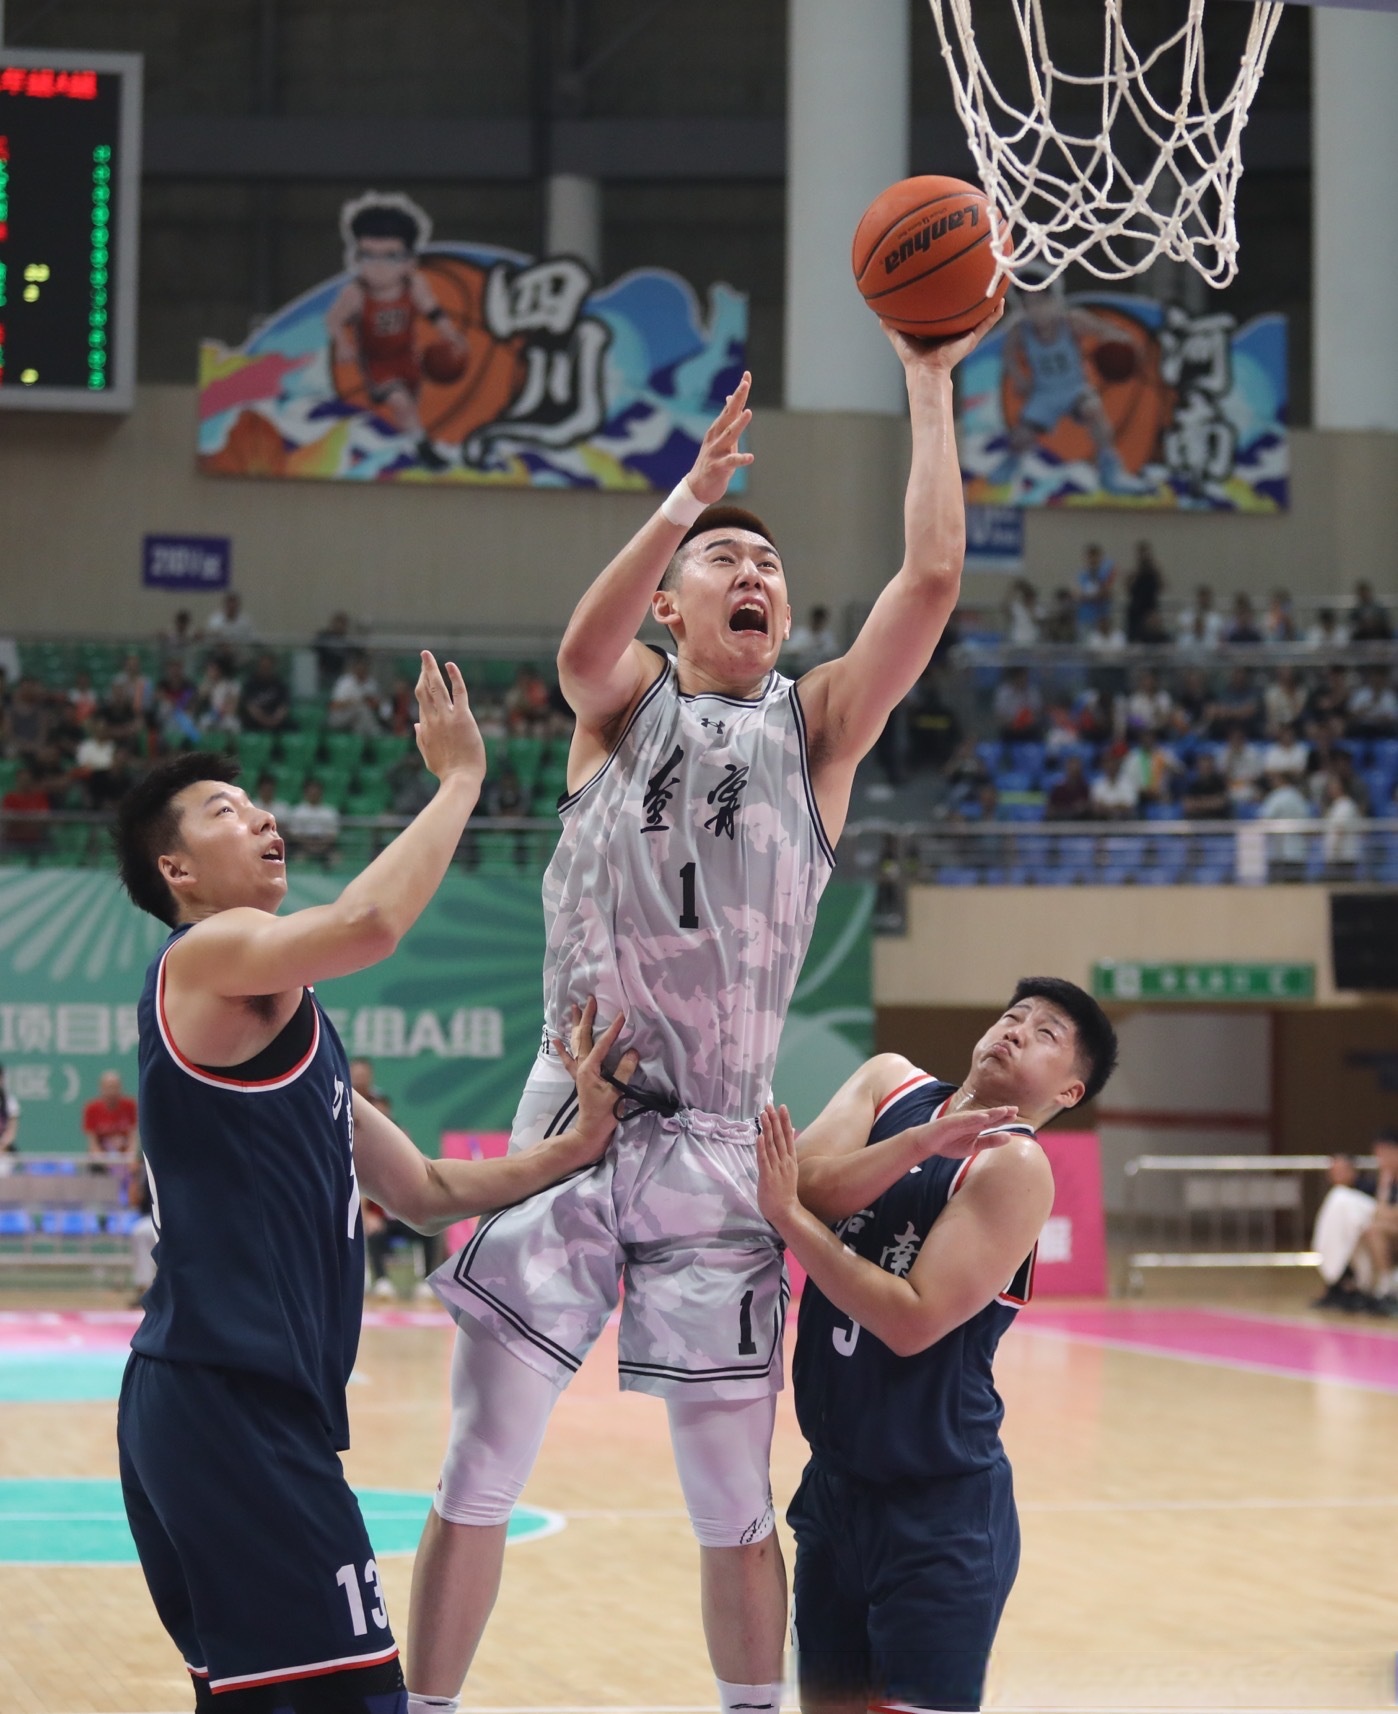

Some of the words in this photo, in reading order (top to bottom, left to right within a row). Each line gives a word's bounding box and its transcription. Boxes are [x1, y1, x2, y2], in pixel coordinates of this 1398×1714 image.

[884, 204, 979, 275] Lanhua
[471, 258, 609, 465] 四川
[1159, 304, 1238, 478] 河南
[679, 862, 699, 929] 1
[738, 1290, 757, 1356] 1
[336, 1558, 388, 1637] 13
